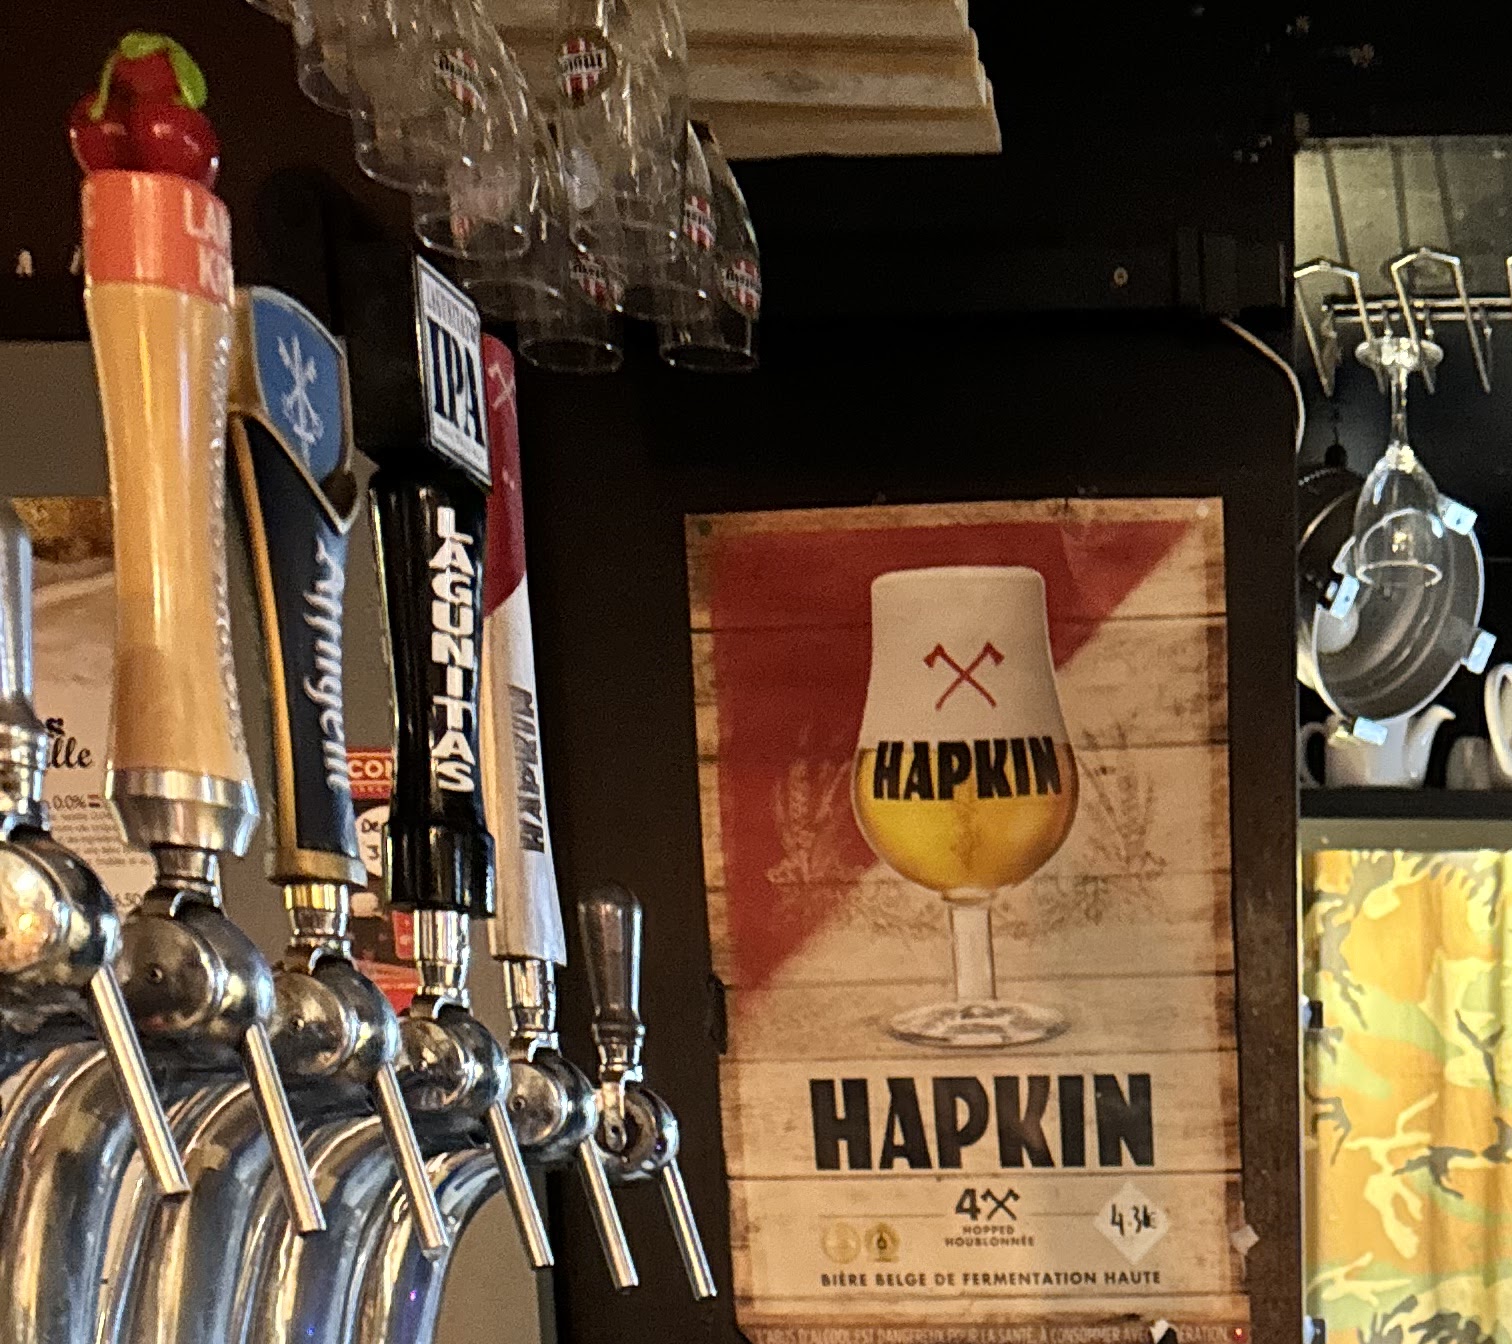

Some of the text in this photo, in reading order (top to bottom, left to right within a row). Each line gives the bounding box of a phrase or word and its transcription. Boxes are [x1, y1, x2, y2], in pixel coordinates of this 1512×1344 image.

[428, 317, 485, 447] IPA
[429, 507, 475, 793] LAGUNITAS
[507, 684, 546, 853] HAPKIN
[873, 737, 1062, 800] HAPKIN
[809, 1073, 1154, 1170] HAPKIN
[821, 1271, 1161, 1287] BIÈRE BELGE DE FERMENTATION HAUTE
[962, 1225, 1015, 1236] HOPPED
